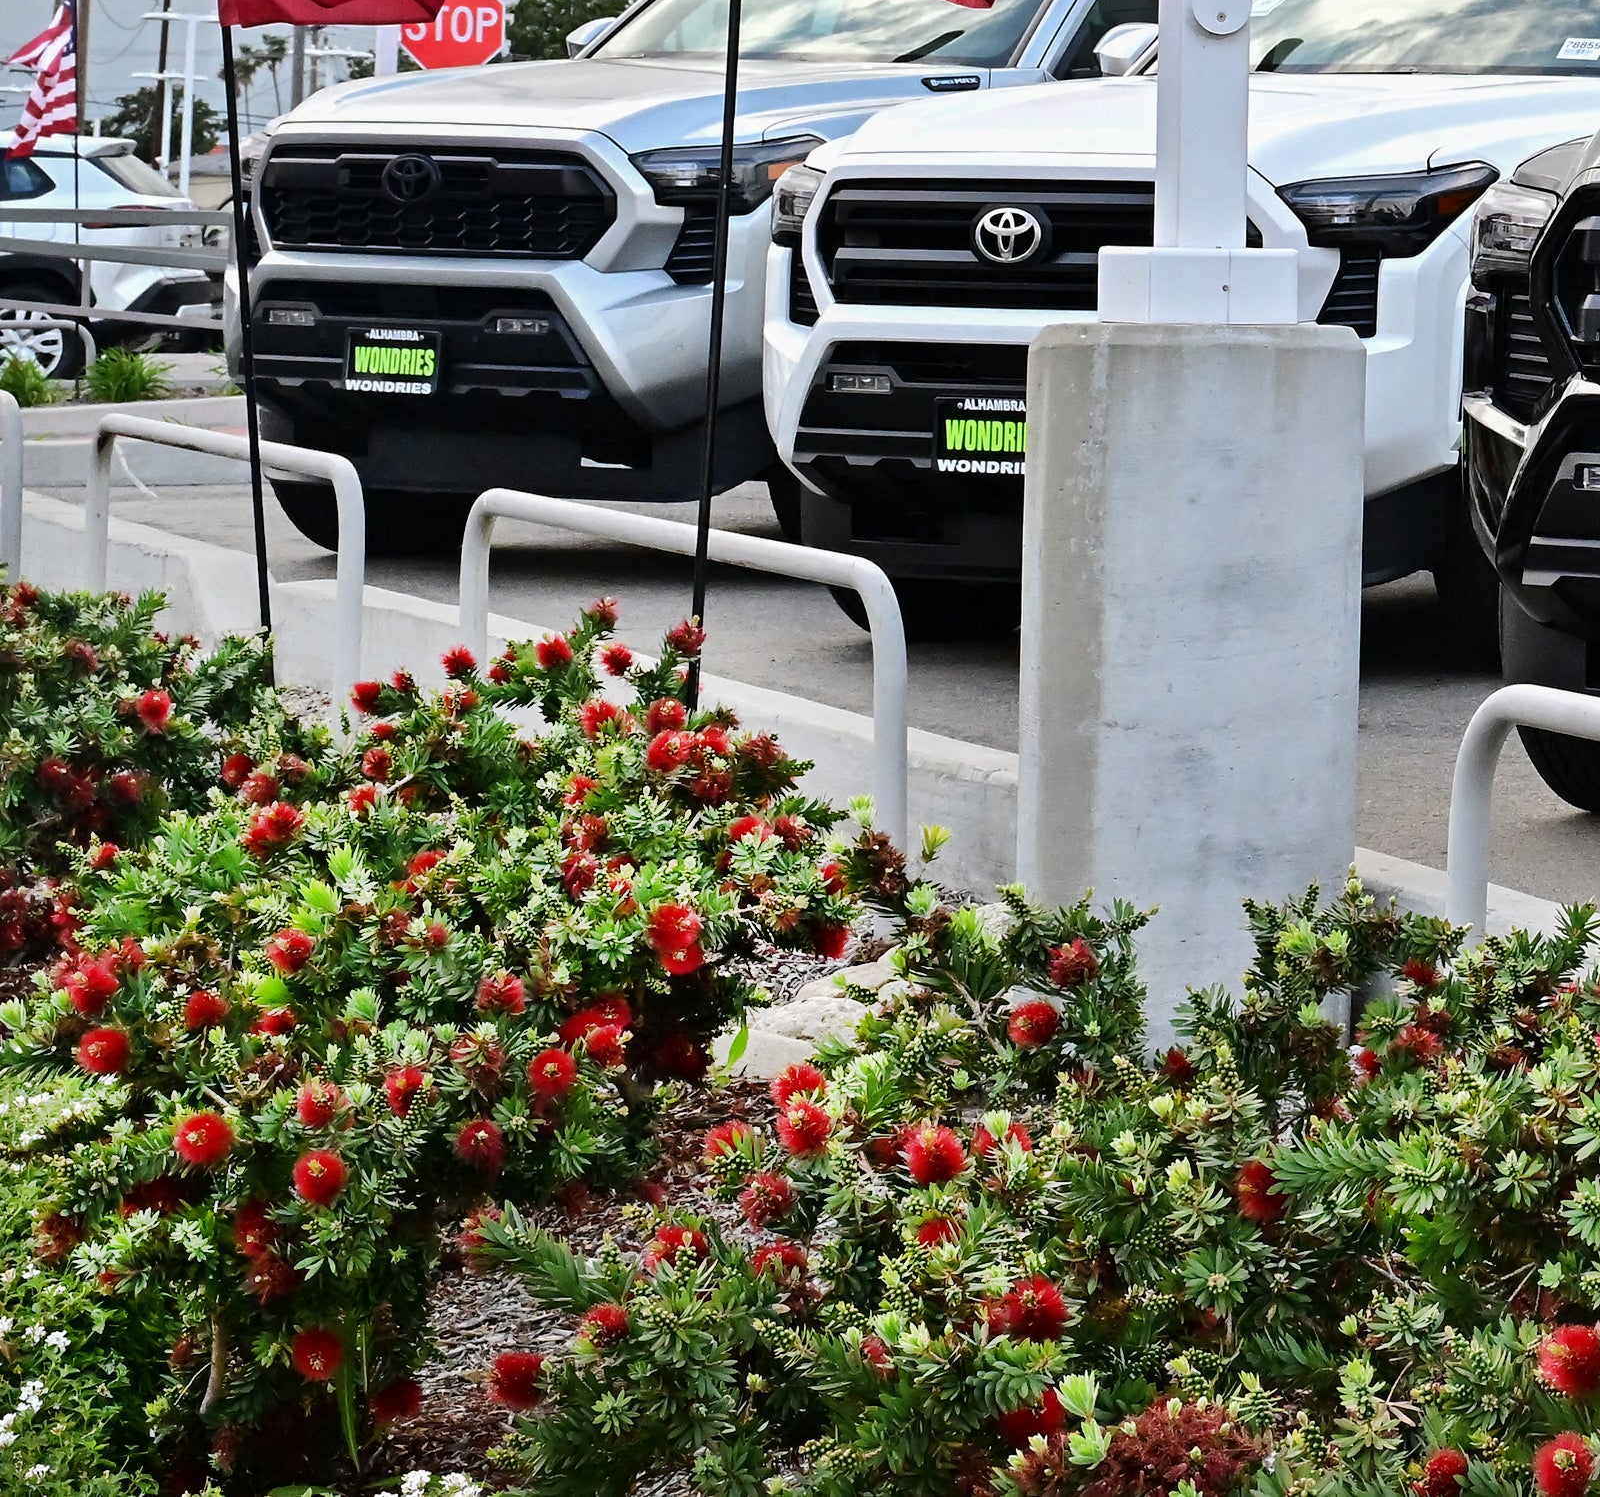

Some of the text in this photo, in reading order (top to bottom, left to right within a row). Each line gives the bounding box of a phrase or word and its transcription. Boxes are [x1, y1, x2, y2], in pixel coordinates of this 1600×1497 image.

[369, 328, 420, 342] ALHAMBRA
[354, 346, 435, 377] WONDRIES
[345, 379, 432, 394] WONDRIES
[963, 398, 1026, 412] ALHAMBRA
[945, 419, 1027, 453] WONDRI
[937, 459, 1026, 475] WONDRI
